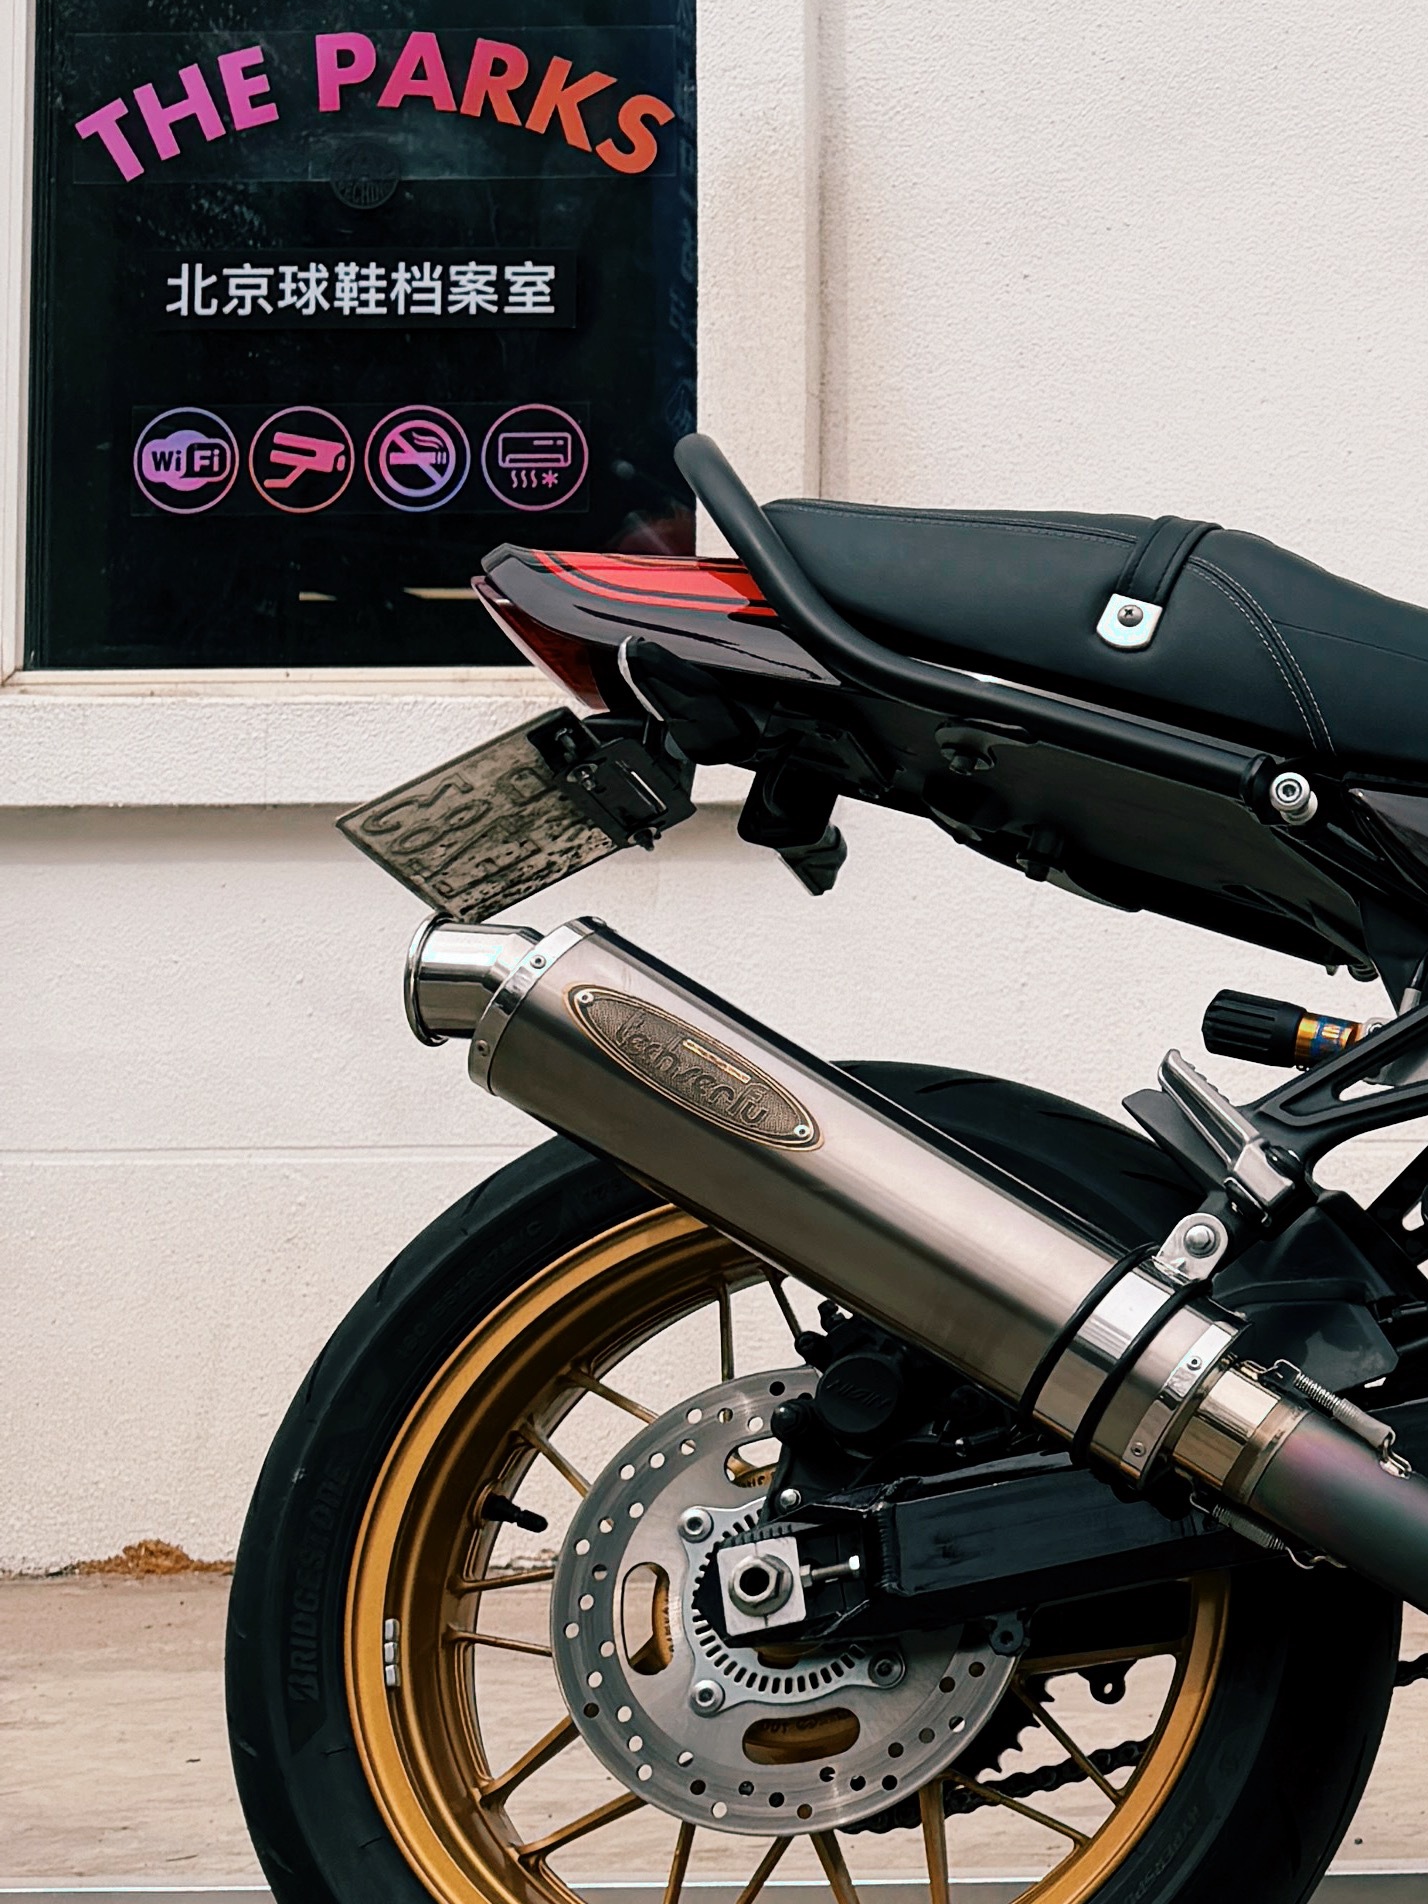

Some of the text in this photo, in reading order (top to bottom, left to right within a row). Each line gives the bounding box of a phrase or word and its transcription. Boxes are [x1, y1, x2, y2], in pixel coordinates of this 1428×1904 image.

[74, 45, 279, 183] THE
[315, 31, 674, 176] PARKS
[165, 260, 556, 317] 北京球鞋档案室
